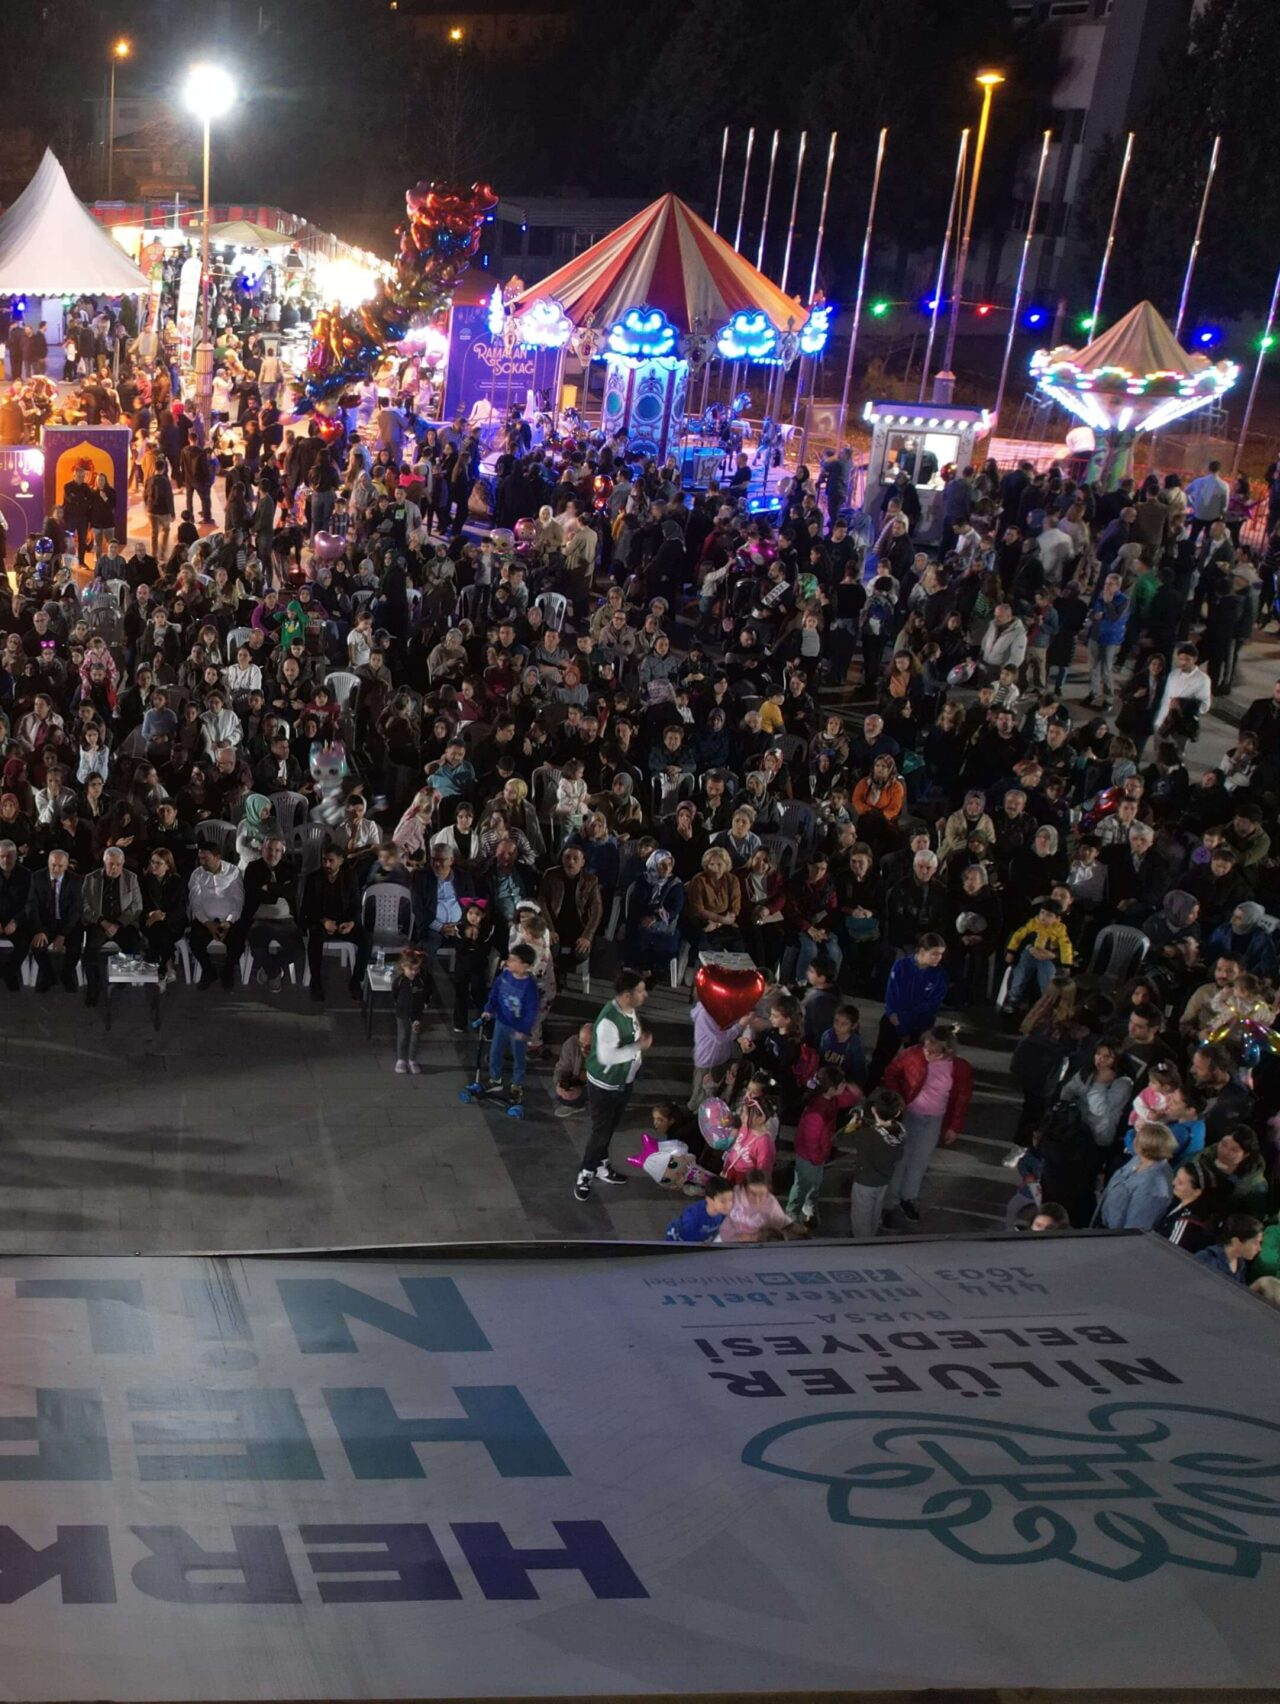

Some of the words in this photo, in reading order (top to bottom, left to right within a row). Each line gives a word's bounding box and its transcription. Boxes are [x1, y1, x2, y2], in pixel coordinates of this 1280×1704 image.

[492, 359, 537, 376] SOKAĞ
[934, 1265, 1035, 1281] 1603
[660, 1284, 923, 1309] nilufer.bel.tr
[959, 1281, 1048, 1297] 444
[814, 1310, 952, 1325] BURSA
[694, 1325, 1129, 1363] BELEDİYESİ
[710, 1357, 1184, 1398] NİLÜFER
